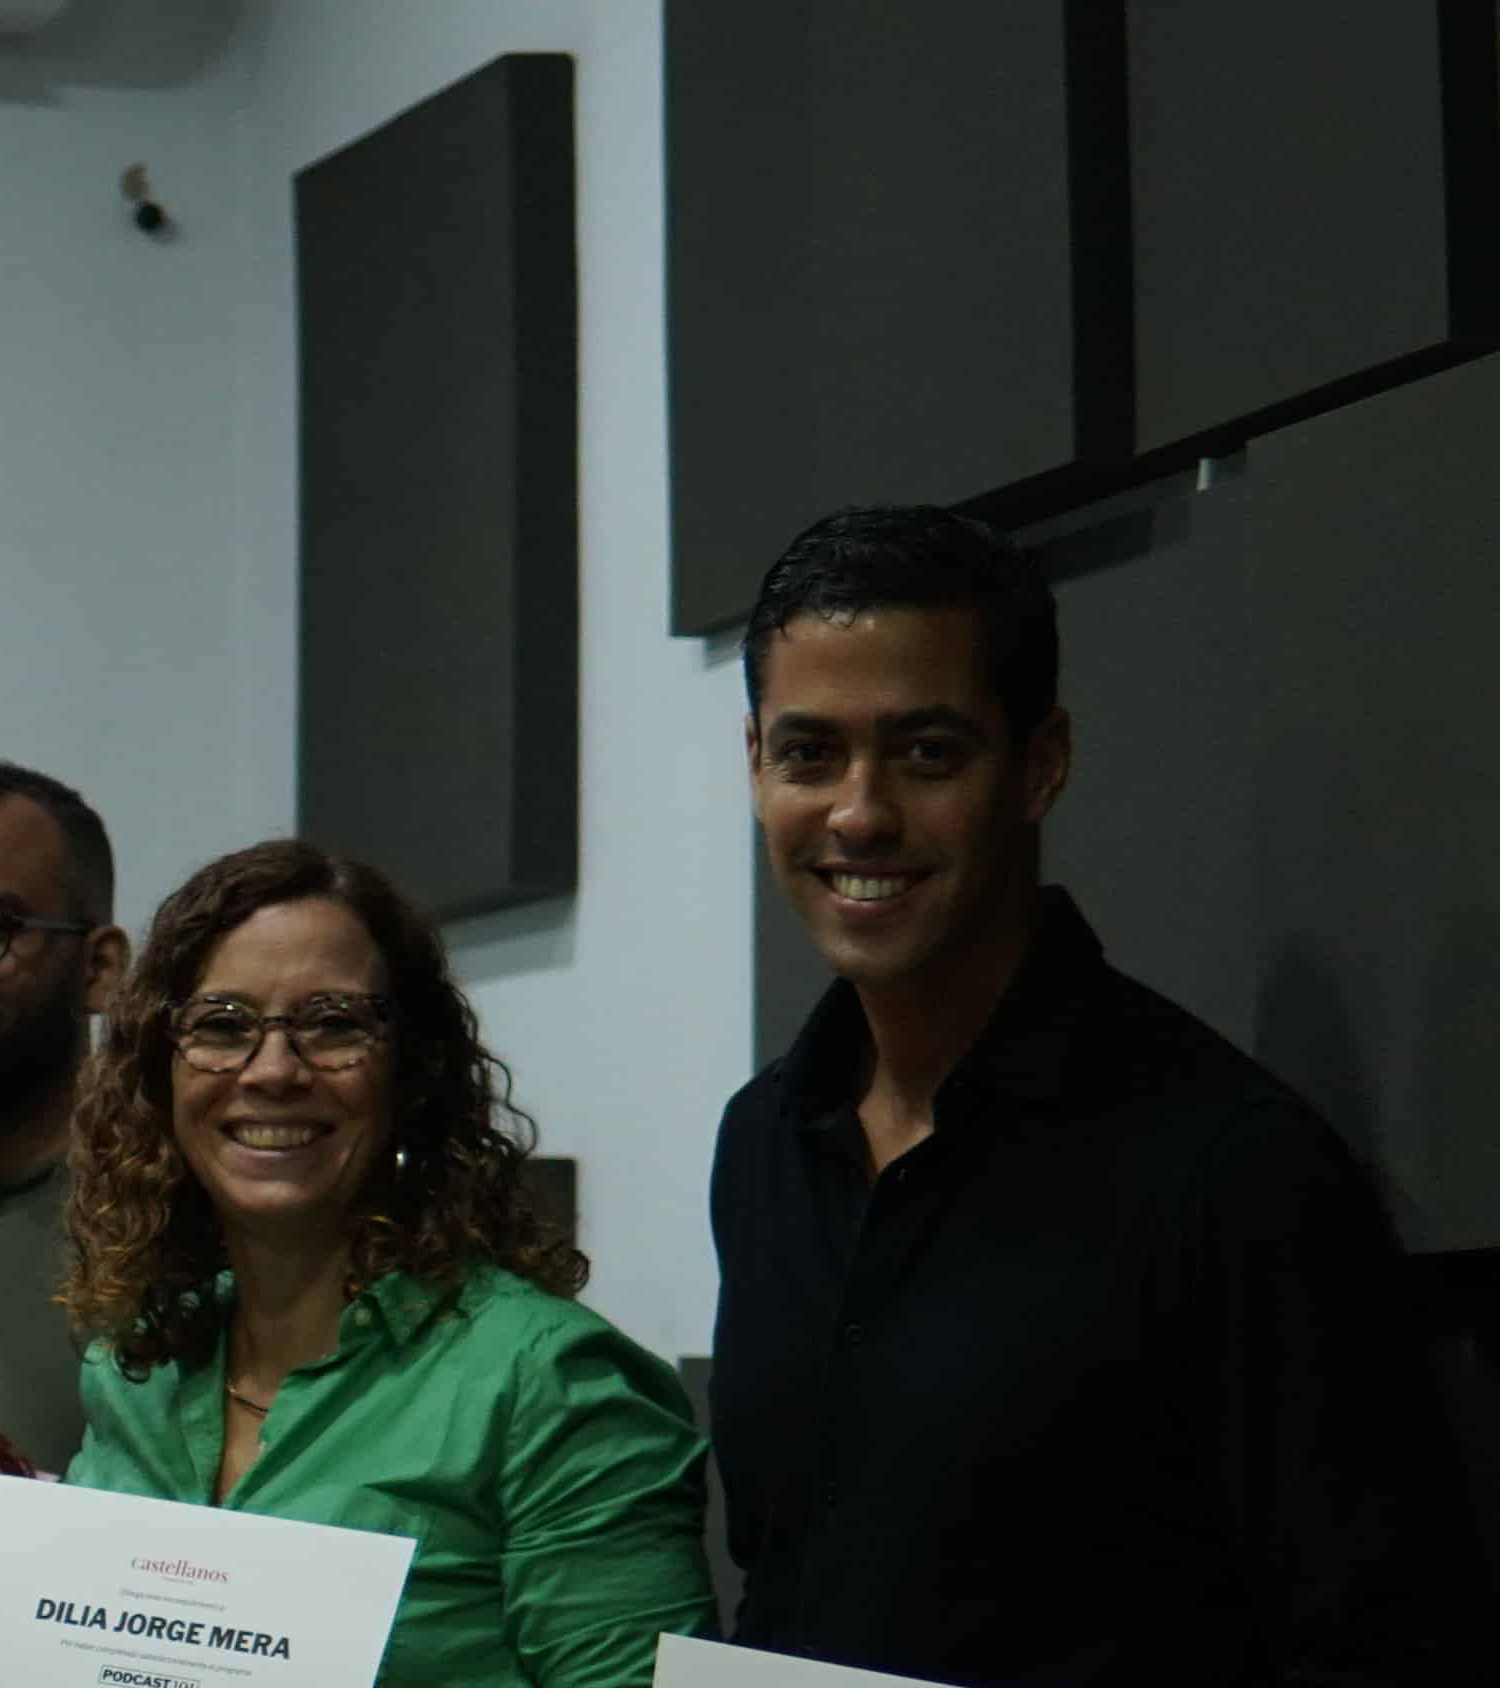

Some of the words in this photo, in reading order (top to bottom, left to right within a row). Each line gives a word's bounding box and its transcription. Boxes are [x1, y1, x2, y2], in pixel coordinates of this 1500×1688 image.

[131, 1557, 228, 1583] castellanos
[36, 1598, 107, 1630] DILIA
[113, 1611, 205, 1645] JORGE
[208, 1626, 290, 1659] MERA
